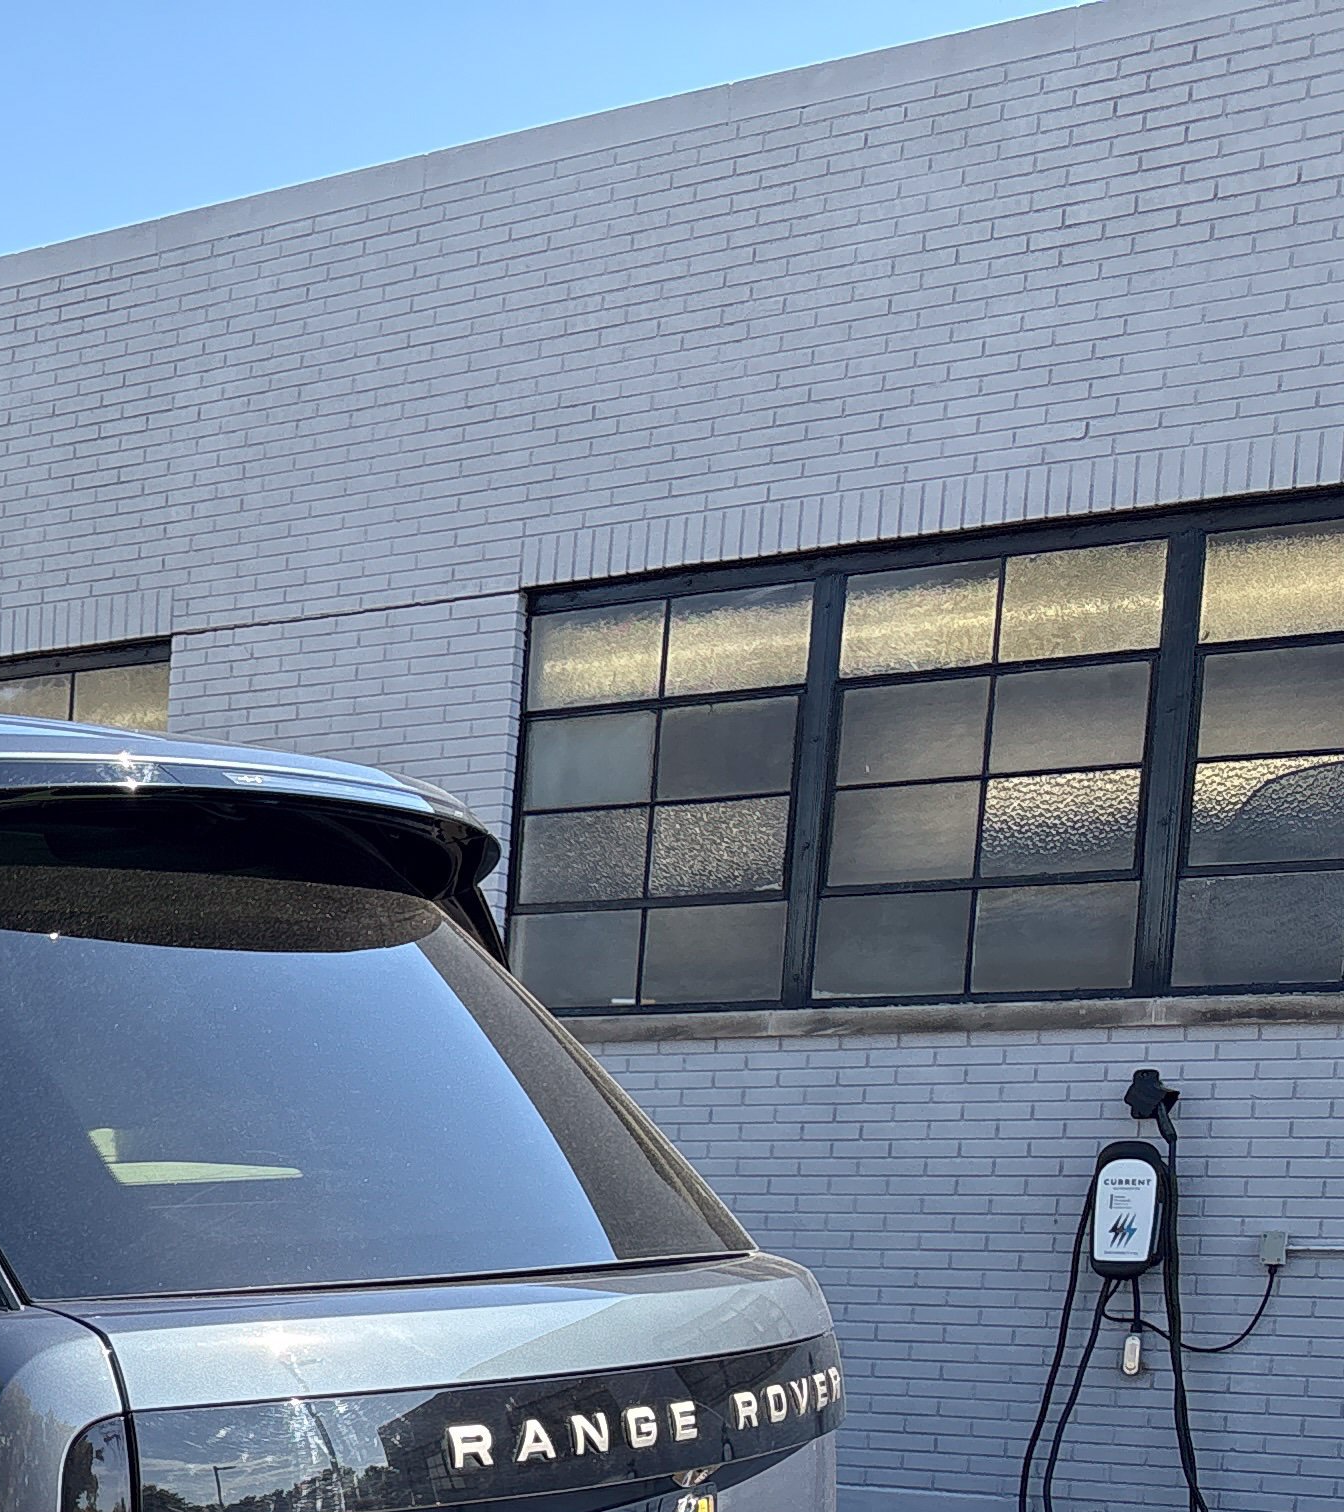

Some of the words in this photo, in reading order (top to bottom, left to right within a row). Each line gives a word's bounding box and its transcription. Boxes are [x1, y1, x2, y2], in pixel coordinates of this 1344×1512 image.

[1103, 1178, 1152, 1186] CURRENT
[445, 1400, 699, 1469] RANGE
[731, 1367, 841, 1431] ROVER
